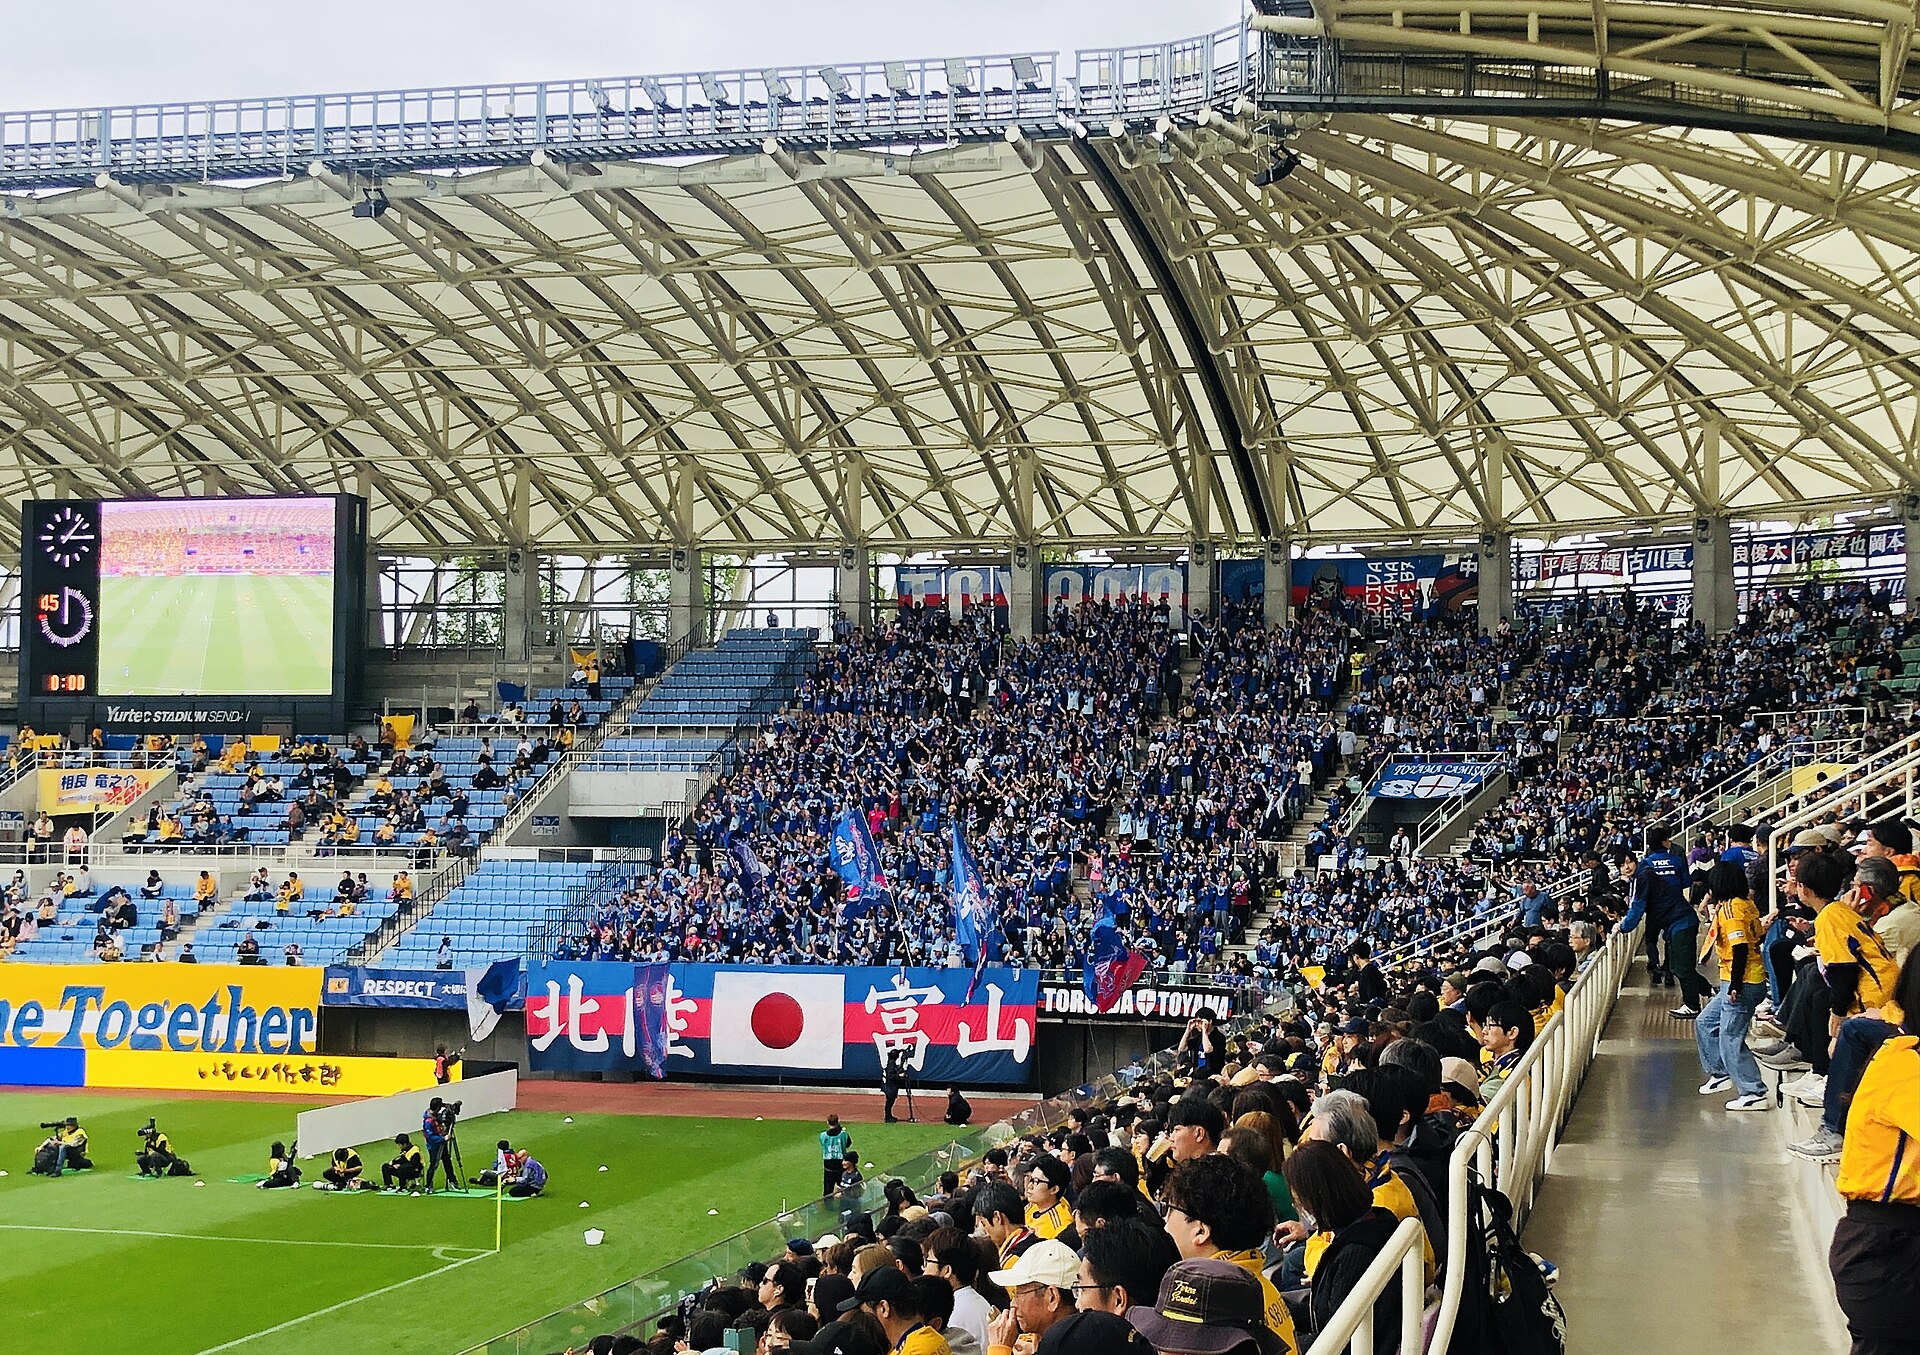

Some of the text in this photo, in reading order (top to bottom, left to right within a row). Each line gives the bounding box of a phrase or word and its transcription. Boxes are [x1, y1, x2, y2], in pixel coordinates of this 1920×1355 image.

[1628, 549, 1693, 572] 古川真
[40, 594, 59, 612] 45
[49, 674, 85, 691] 0:00
[106, 705, 151, 723] Yurtec
[152, 710, 208, 723] STADIUM
[61, 773, 87, 790] 相良
[363, 979, 437, 997] RESPECT
[54, 984, 317, 1054] Together
[864, 974, 1030, 1072] 富山
